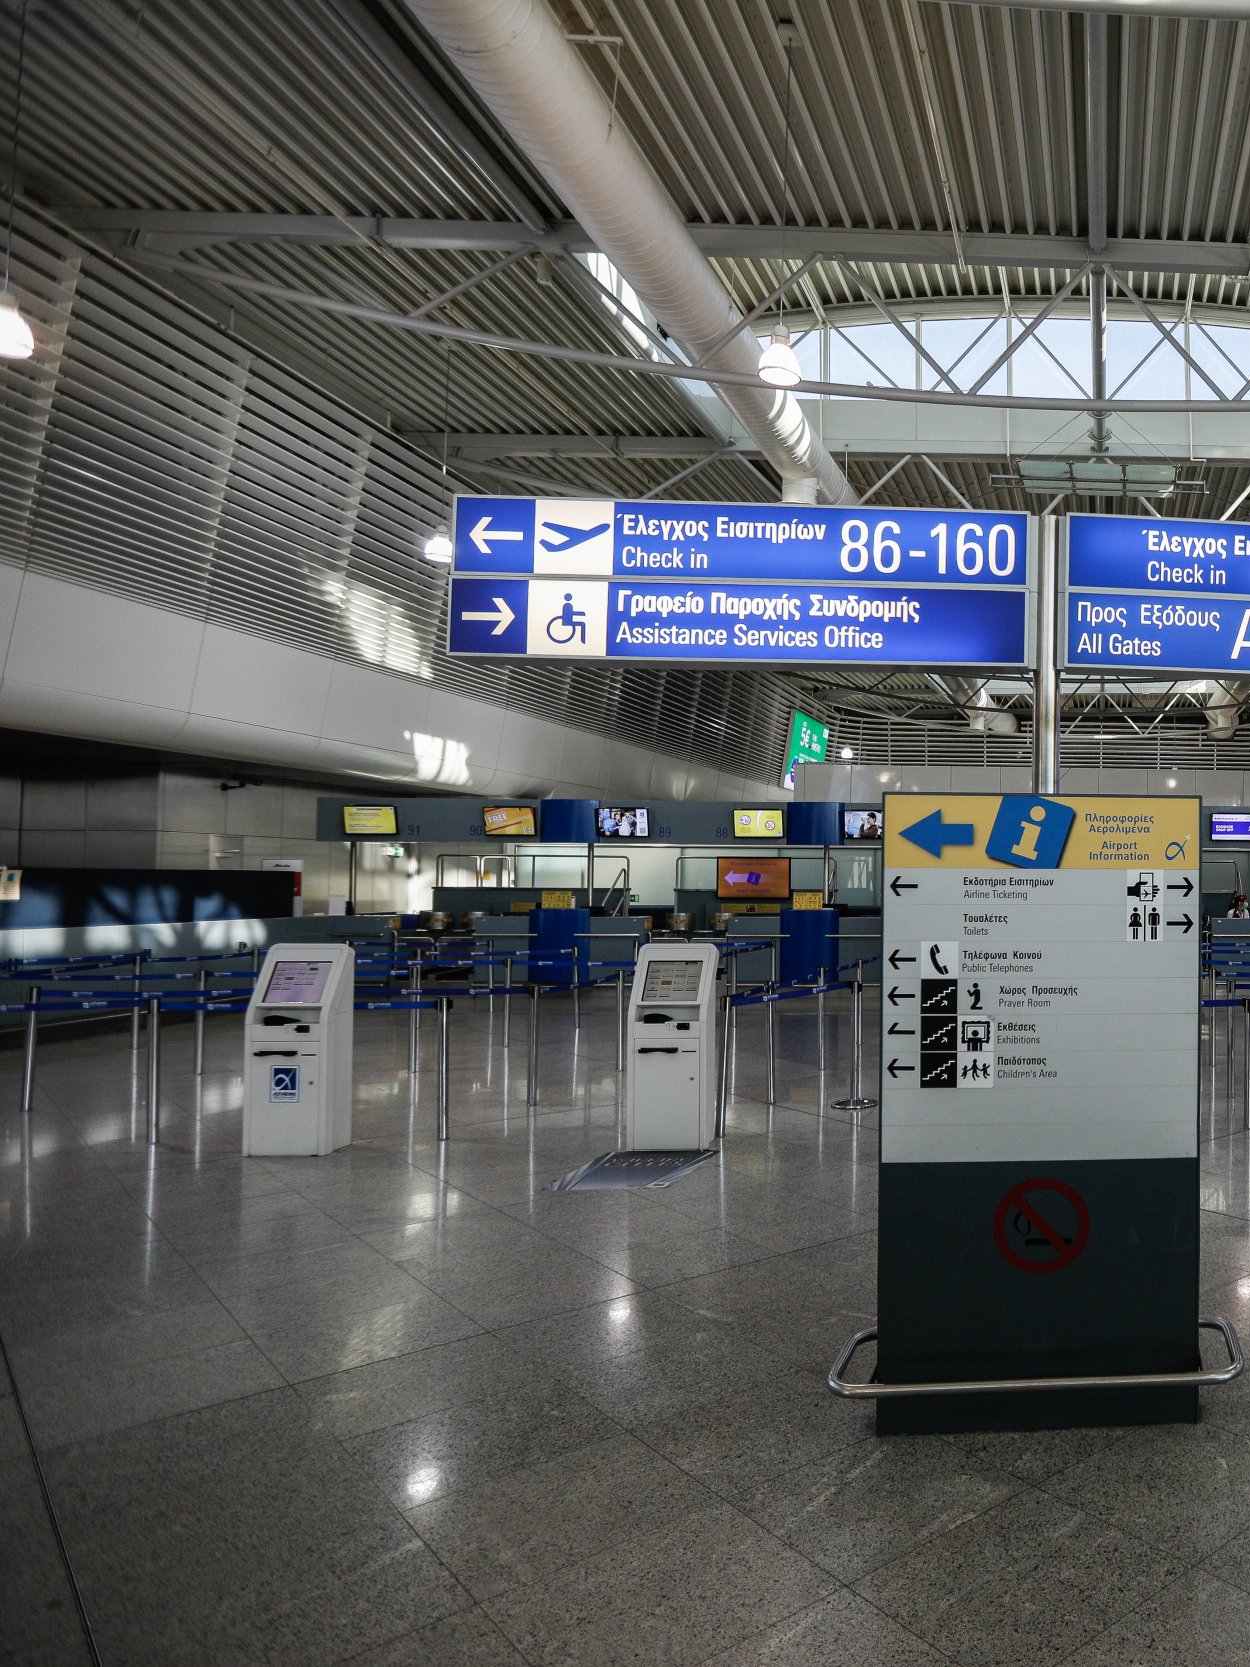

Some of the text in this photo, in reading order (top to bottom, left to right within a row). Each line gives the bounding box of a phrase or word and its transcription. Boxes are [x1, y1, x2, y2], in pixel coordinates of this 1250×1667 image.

[715, 517, 826, 544] Εισιτηρίων
[839, 519, 1017, 577] 86-160
[622, 545, 708, 569] Check in
[1147, 562, 1227, 586] Check in
[616, 589, 920, 623] Γραφείο Παροχής Συνδρομής
[1077, 601, 1221, 630] Προς Εξόδους
[616, 624, 883, 650] Assistance Services Office
[1077, 633, 1162, 657] All Gates
[488, 813, 508, 824] FREE
[1085, 812, 1155, 825] Πληροφορίες
[408, 824, 420, 836] 91
[470, 824, 482, 836] 90
[659, 826, 672, 838] 89
[716, 828, 728, 838] 88
[1088, 824, 1151, 836] Αερολιμένα
[1102, 840, 1138, 852] Airport
[1089, 852, 1150, 862] Information
[963, 876, 1054, 888] Εκδοτήρια Εισιτηρίων
[963, 890, 1028, 902] Airline Ticketing
[962, 913, 1008, 925] Τουαλέτες
[962, 926, 989, 936] Toilets
[962, 950, 1042, 962] Τηλέφωνα Κοινού
[962, 963, 1034, 975] Public Telephones
[998, 985, 1078, 997] Χώρος Προσευχής
[998, 998, 1051, 1010] Prayer Room
[997, 1022, 1036, 1034] Εκθέσεις
[997, 1034, 1040, 1045] Exhibitions
[997, 1056, 1047, 1068] Παιδότοπος
[997, 1068, 1058, 1078] Children's Area
